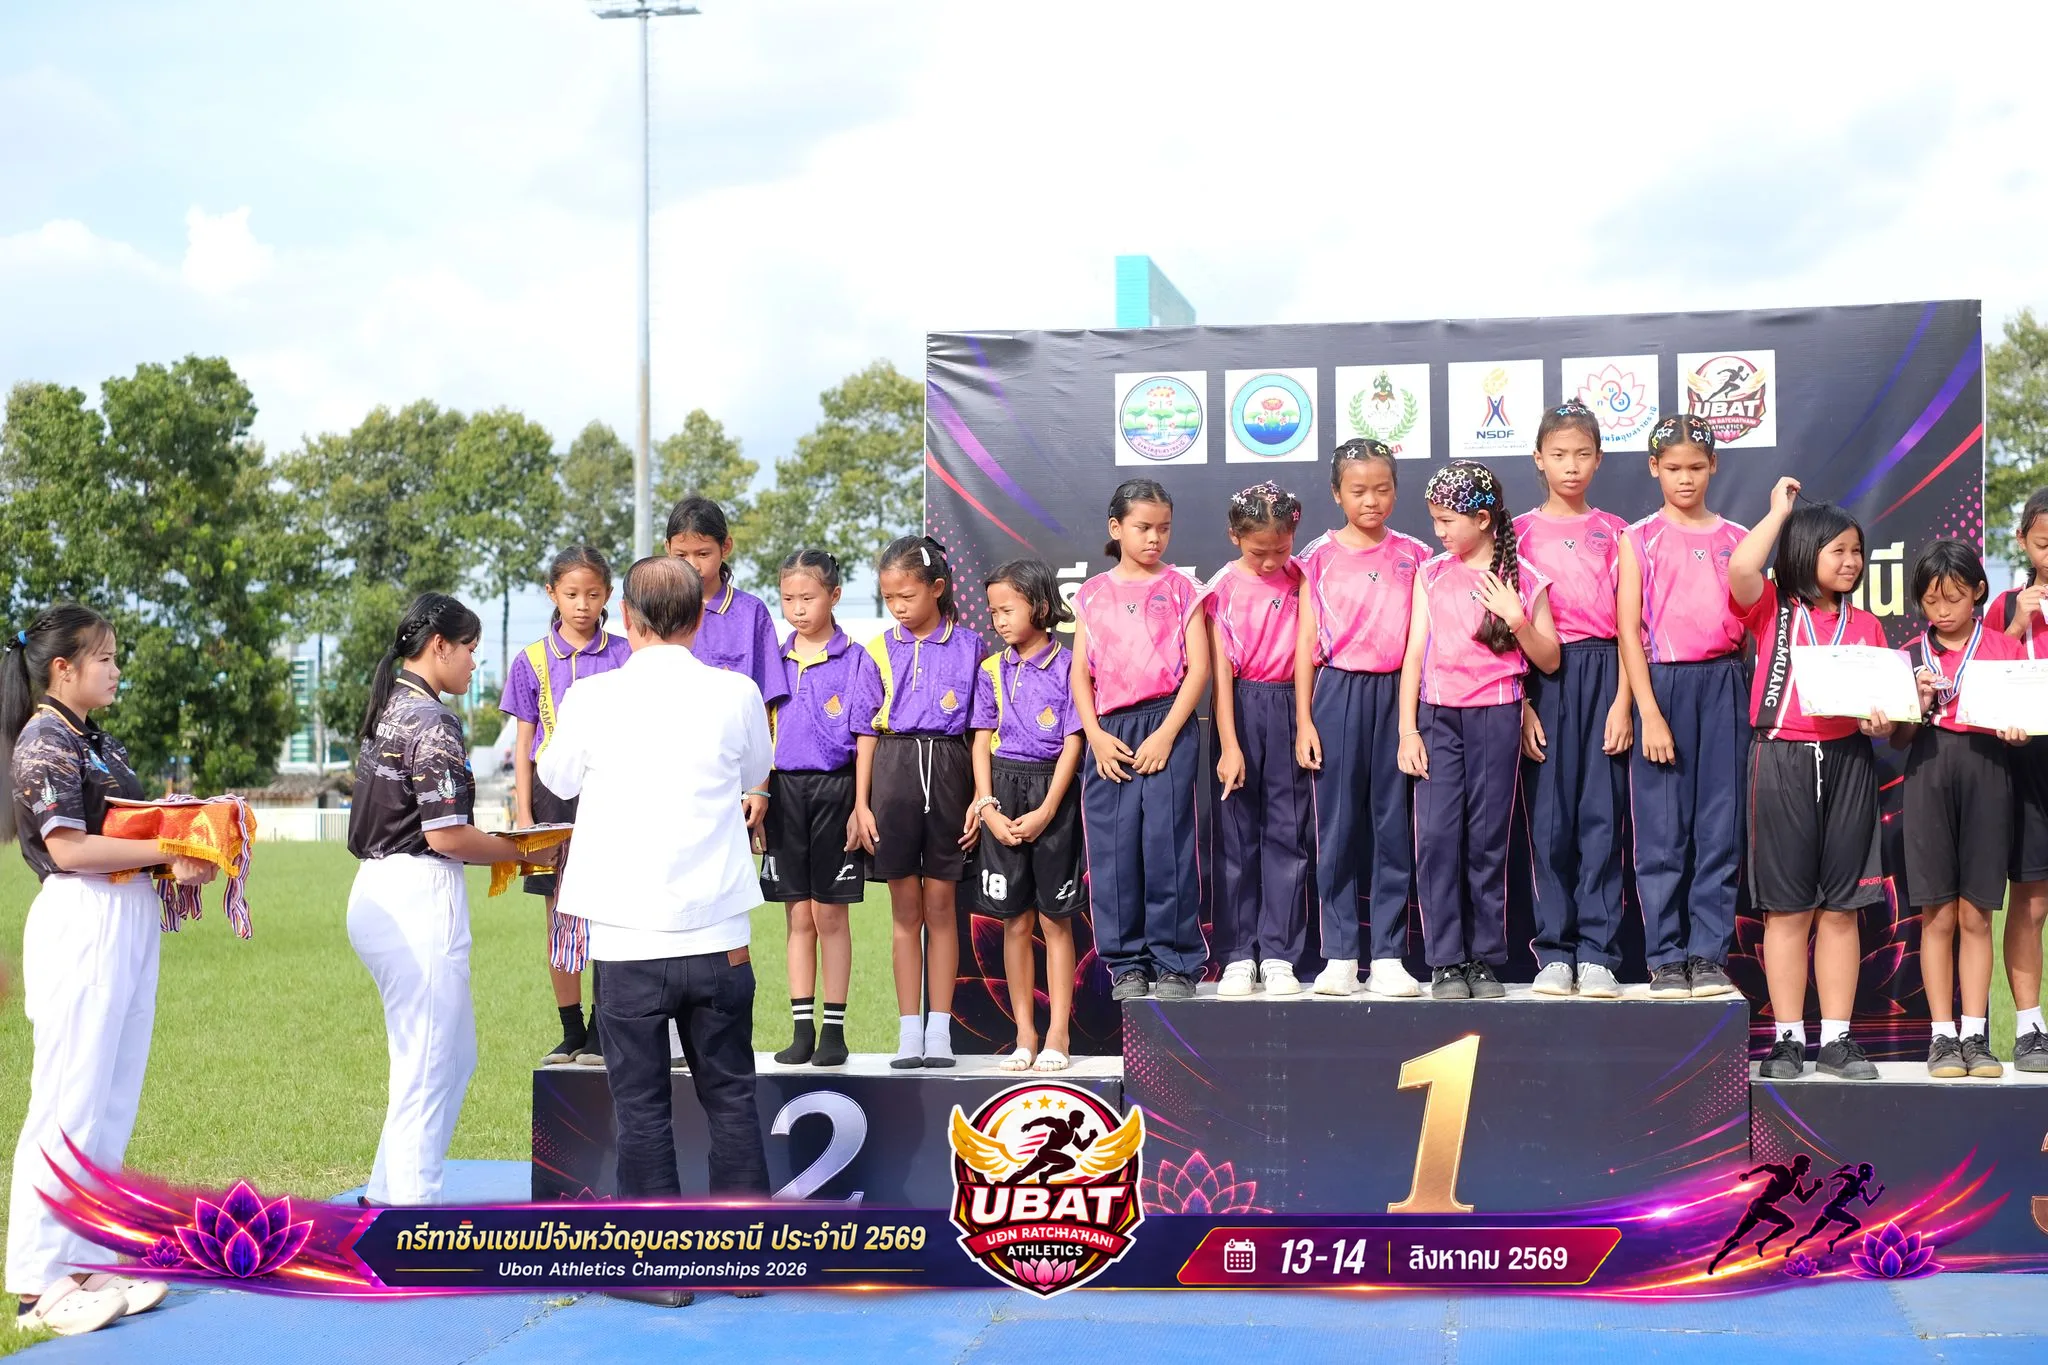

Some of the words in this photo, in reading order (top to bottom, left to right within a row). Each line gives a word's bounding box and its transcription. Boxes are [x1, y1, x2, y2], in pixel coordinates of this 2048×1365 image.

[1693, 400, 1760, 418] UBAT
[1476, 429, 1515, 440] NSDF
[1711, 423, 1744, 431] ATHLETICS
[981, 868, 1008, 900] 18
[1859, 876, 1882, 887] SPORT
[1387, 1035, 1481, 1214] 1
[771, 1090, 868, 1210] 2
